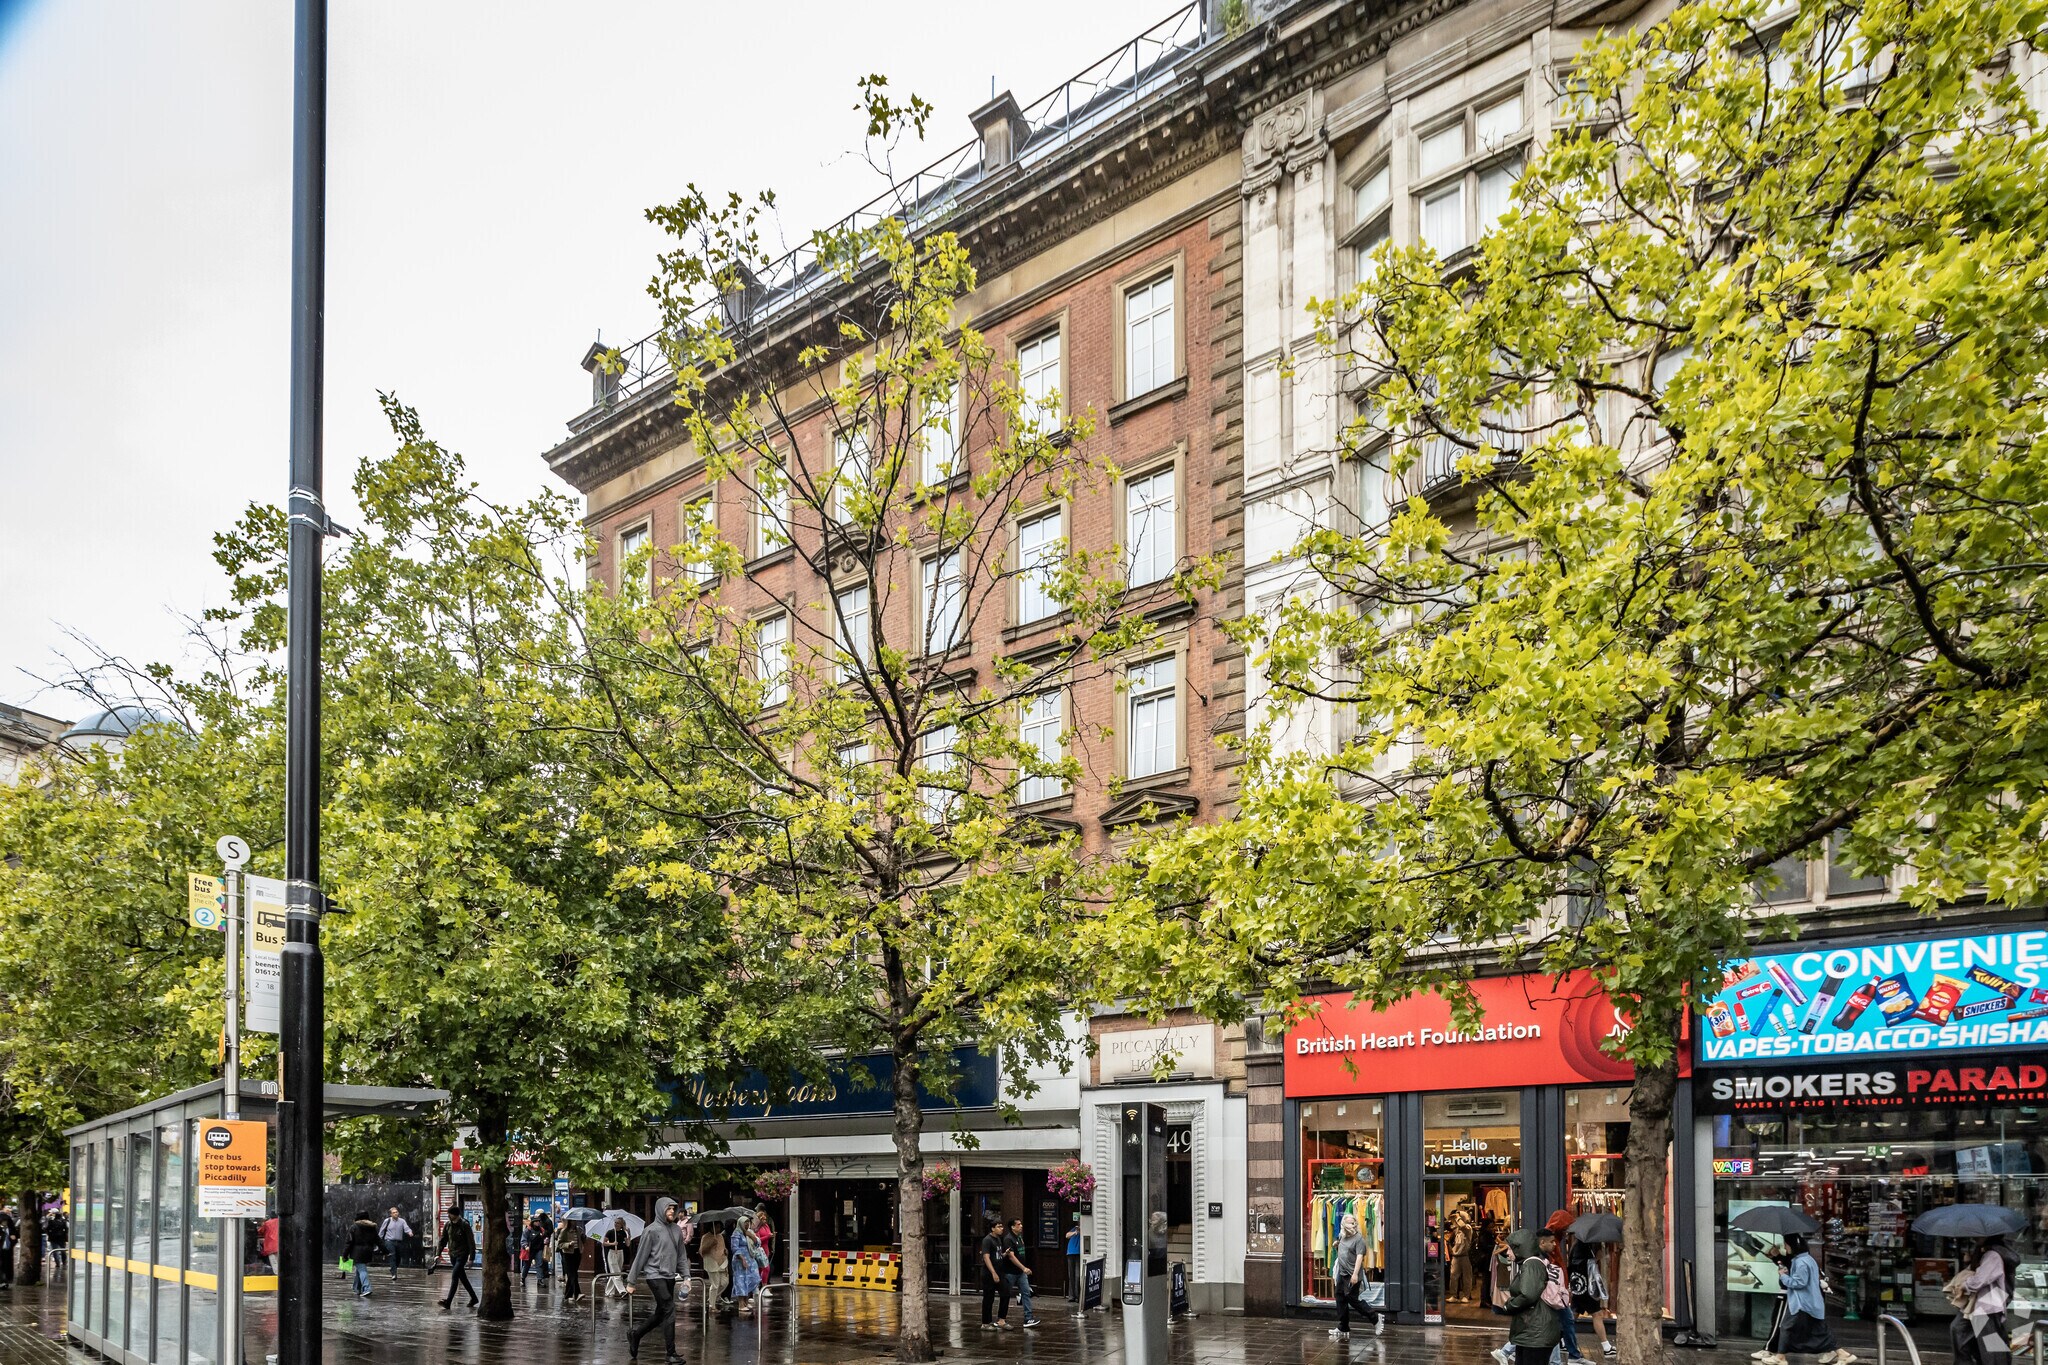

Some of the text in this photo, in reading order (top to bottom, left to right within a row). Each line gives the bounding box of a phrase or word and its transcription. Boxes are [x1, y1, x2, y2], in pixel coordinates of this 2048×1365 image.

[228, 841, 240, 860] S
[194, 877, 213, 887] free
[194, 884, 211, 894] bus
[201, 911, 209, 922] 2
[256, 931, 278, 945] Bus
[1792, 931, 2048, 982] CONVENIE
[1965, 998, 2006, 1016] SNICKERS
[1112, 1035, 1201, 1055] PICCADILLY
[1296, 1022, 1541, 1055] British Heart Foundation
[1712, 1064, 2048, 1100] SMOKERS PARAD
[1735, 1101, 1773, 1109] VAPES
[1790, 1099, 1826, 1108] E-CIG
[1843, 1096, 1904, 1106] E-LIQUID
[1925, 1094, 1977, 1103] SHISHA
[1452, 1138, 1488, 1151] Hello
[205, 1152, 242, 1161] Free bus
[1431, 1154, 1512, 1166] Manchester
[205, 1164, 224, 1172] stop
[1713, 1161, 1751, 1174] VAPE
[204, 1173, 247, 1183] Piccadilly
